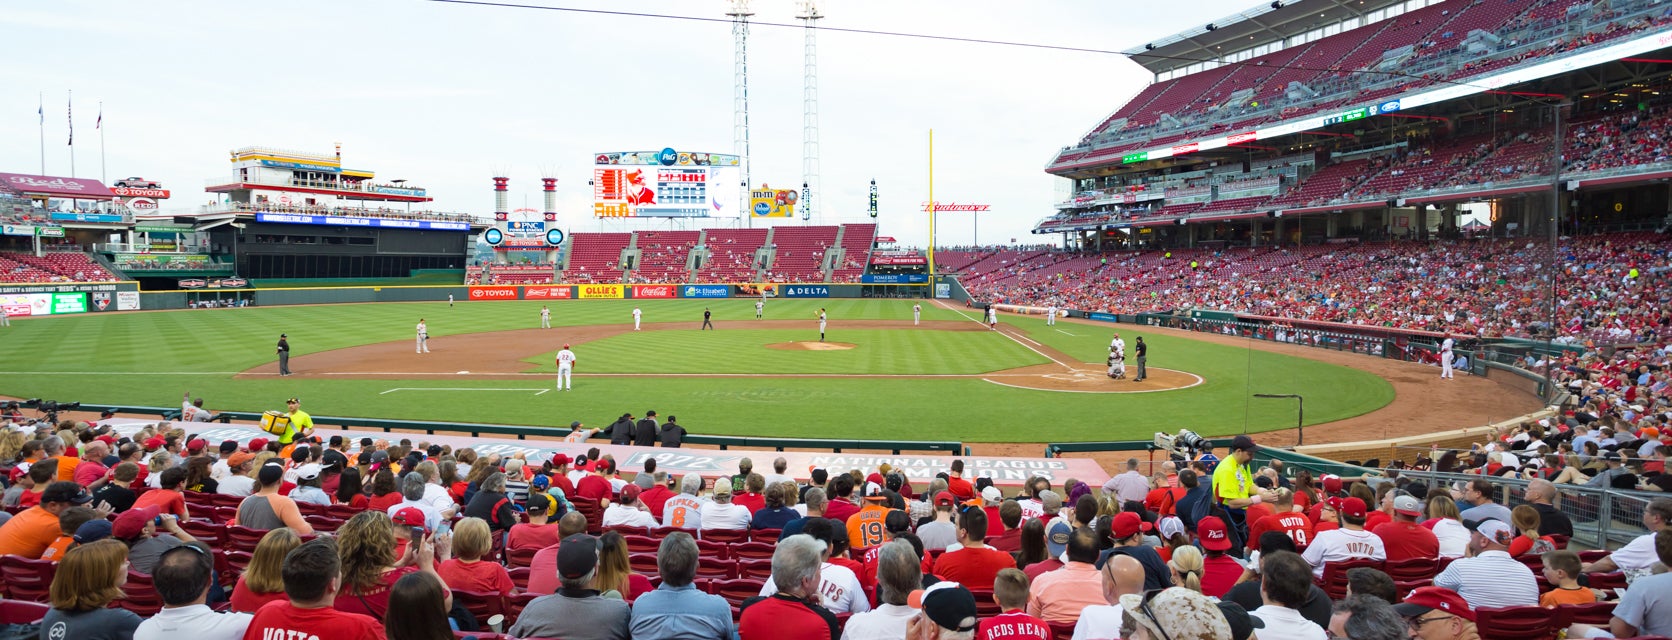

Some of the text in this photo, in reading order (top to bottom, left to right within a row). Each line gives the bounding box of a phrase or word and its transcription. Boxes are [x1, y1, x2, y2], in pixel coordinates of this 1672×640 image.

[130, 189, 165, 197] TOYOTA
[184, 413, 194, 422] 21
[634, 452, 713, 468] 1972
[813, 456, 945, 468] NATIONAL
[961, 459, 1065, 470] LEAGUE
[667, 498, 700, 511] RIPKEN
[672, 507, 687, 527] 8
[1279, 517, 1304, 528] VOTTO
[860, 521, 884, 547] 19
[1346, 542, 1375, 556] VOTTO
[820, 579, 844, 602] IPS
[986, 624, 1015, 640] REDS
